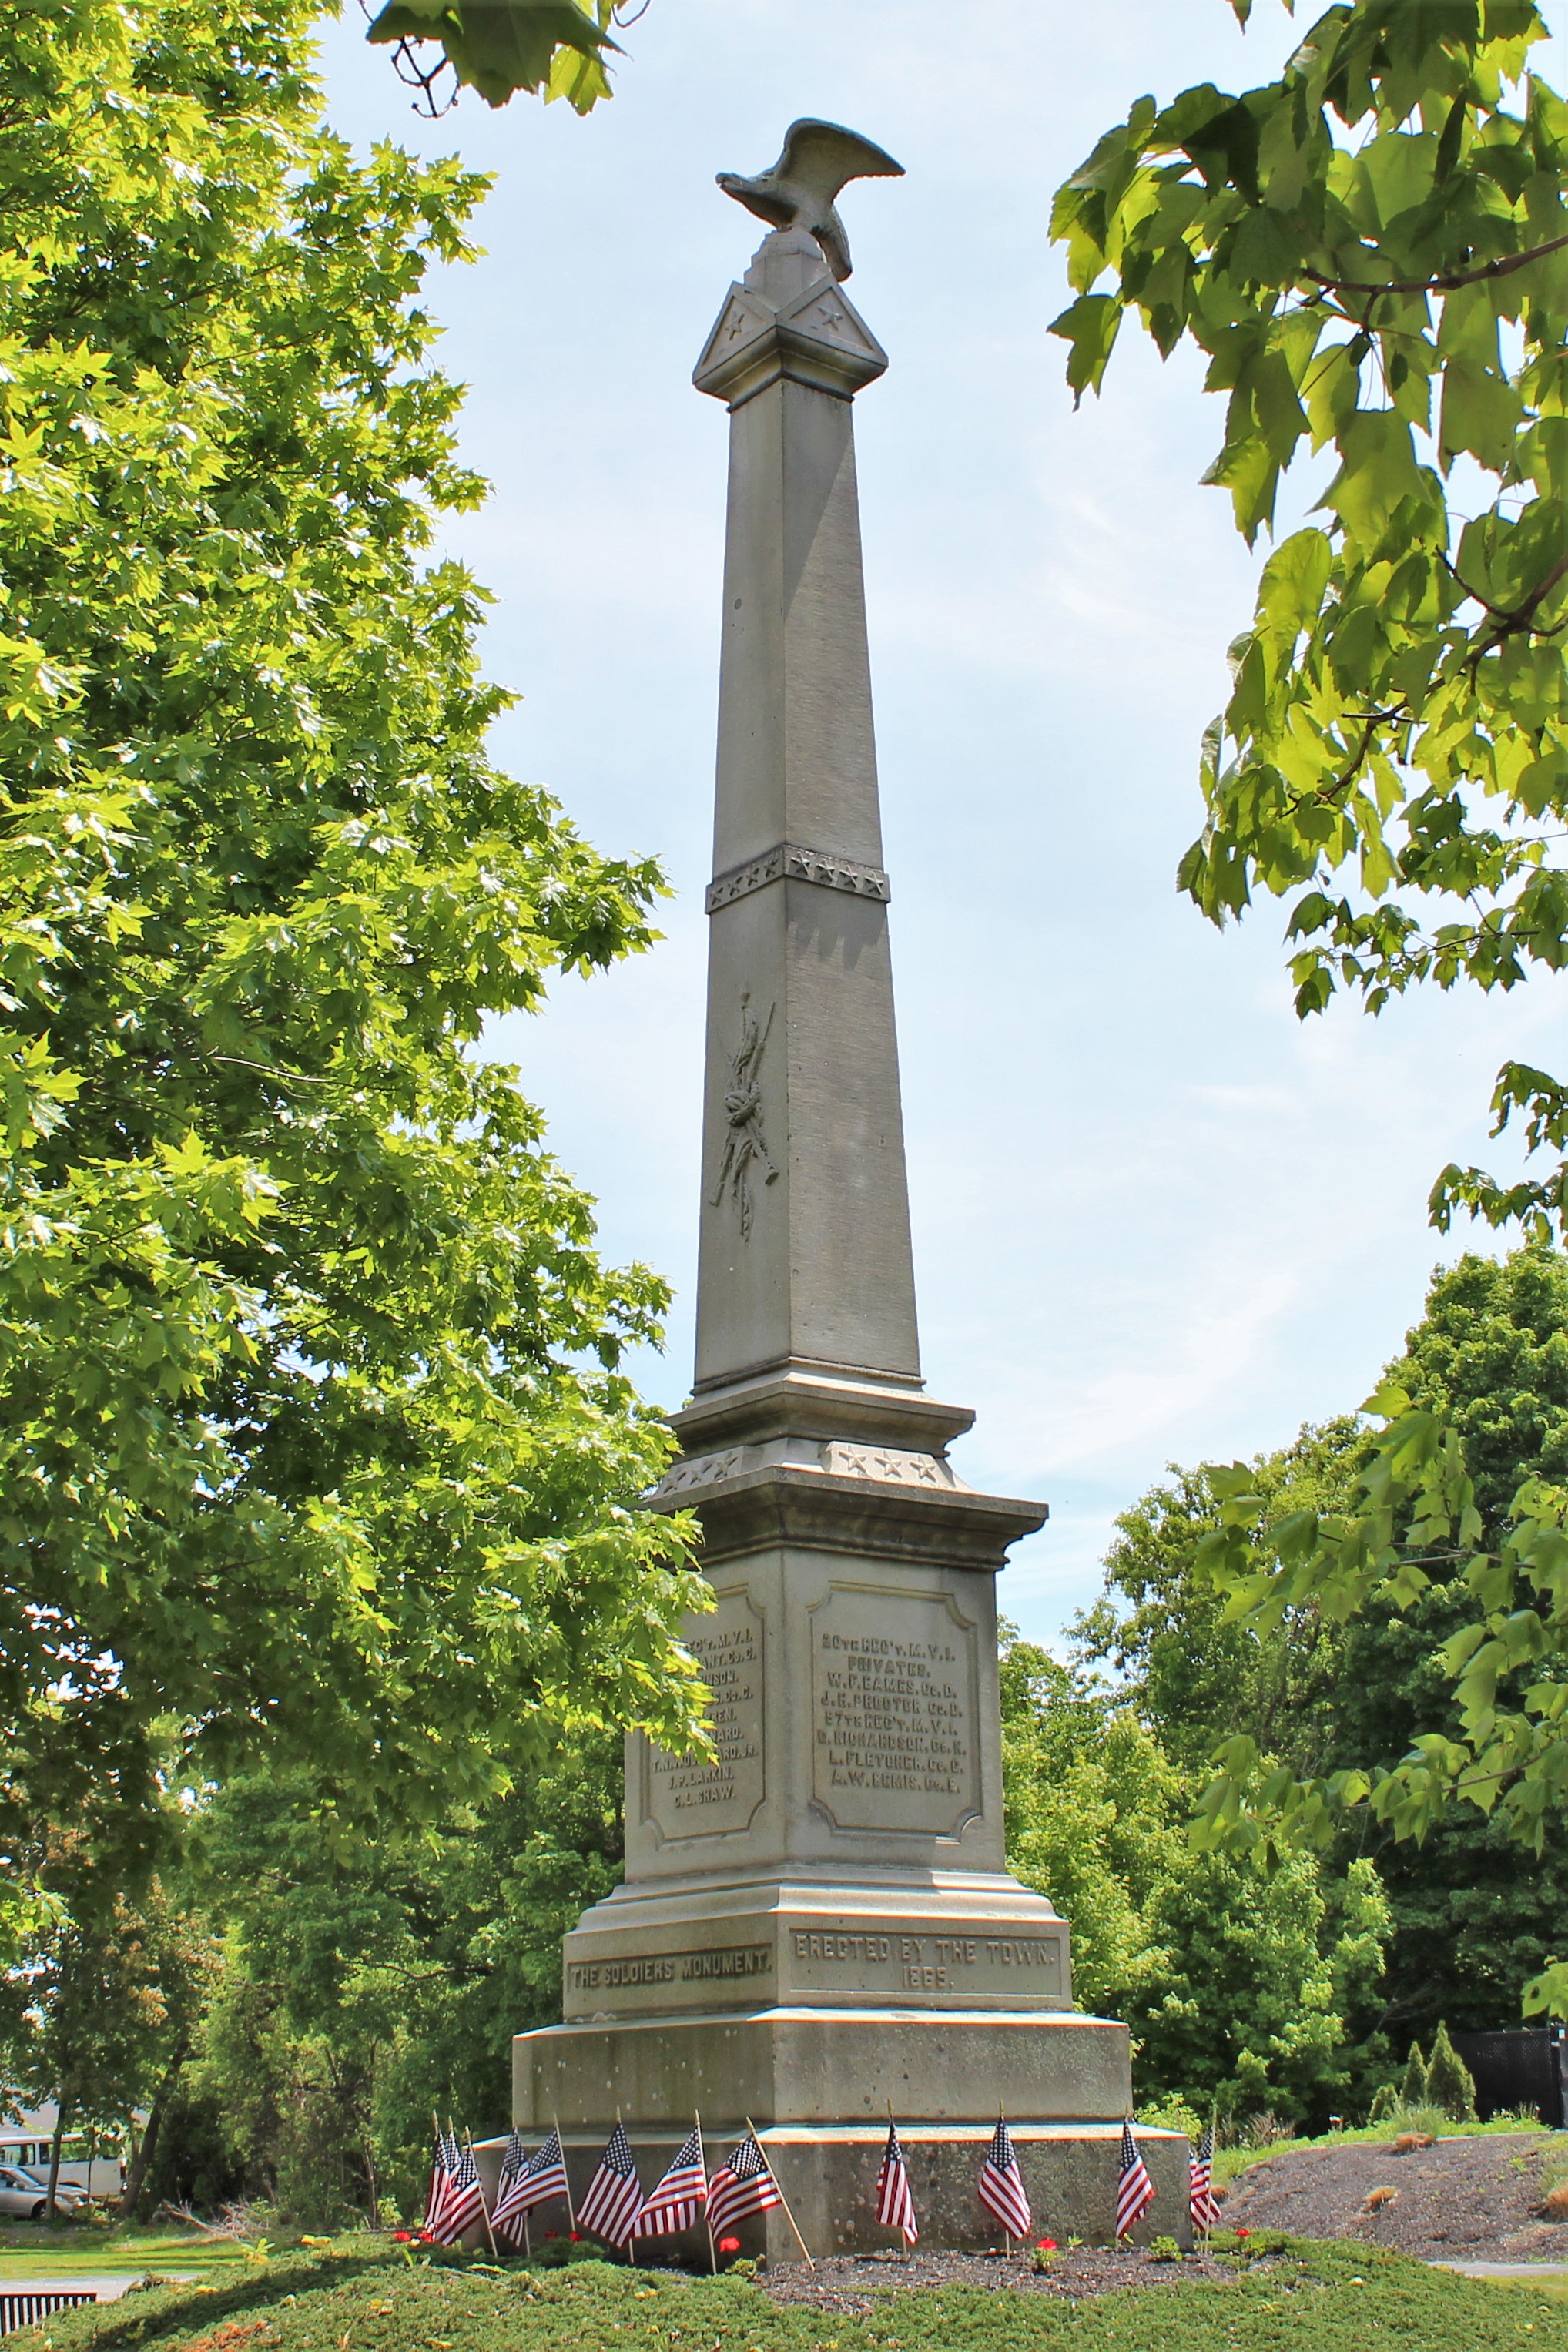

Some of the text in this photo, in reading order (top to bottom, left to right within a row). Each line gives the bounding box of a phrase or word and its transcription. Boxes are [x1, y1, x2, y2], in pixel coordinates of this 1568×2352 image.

[848, 1656, 931, 1678] PRIVATES.
[796, 1934, 1055, 1965] ERECTED BY THE TOWN.
[571, 1966, 599, 1988] THE
